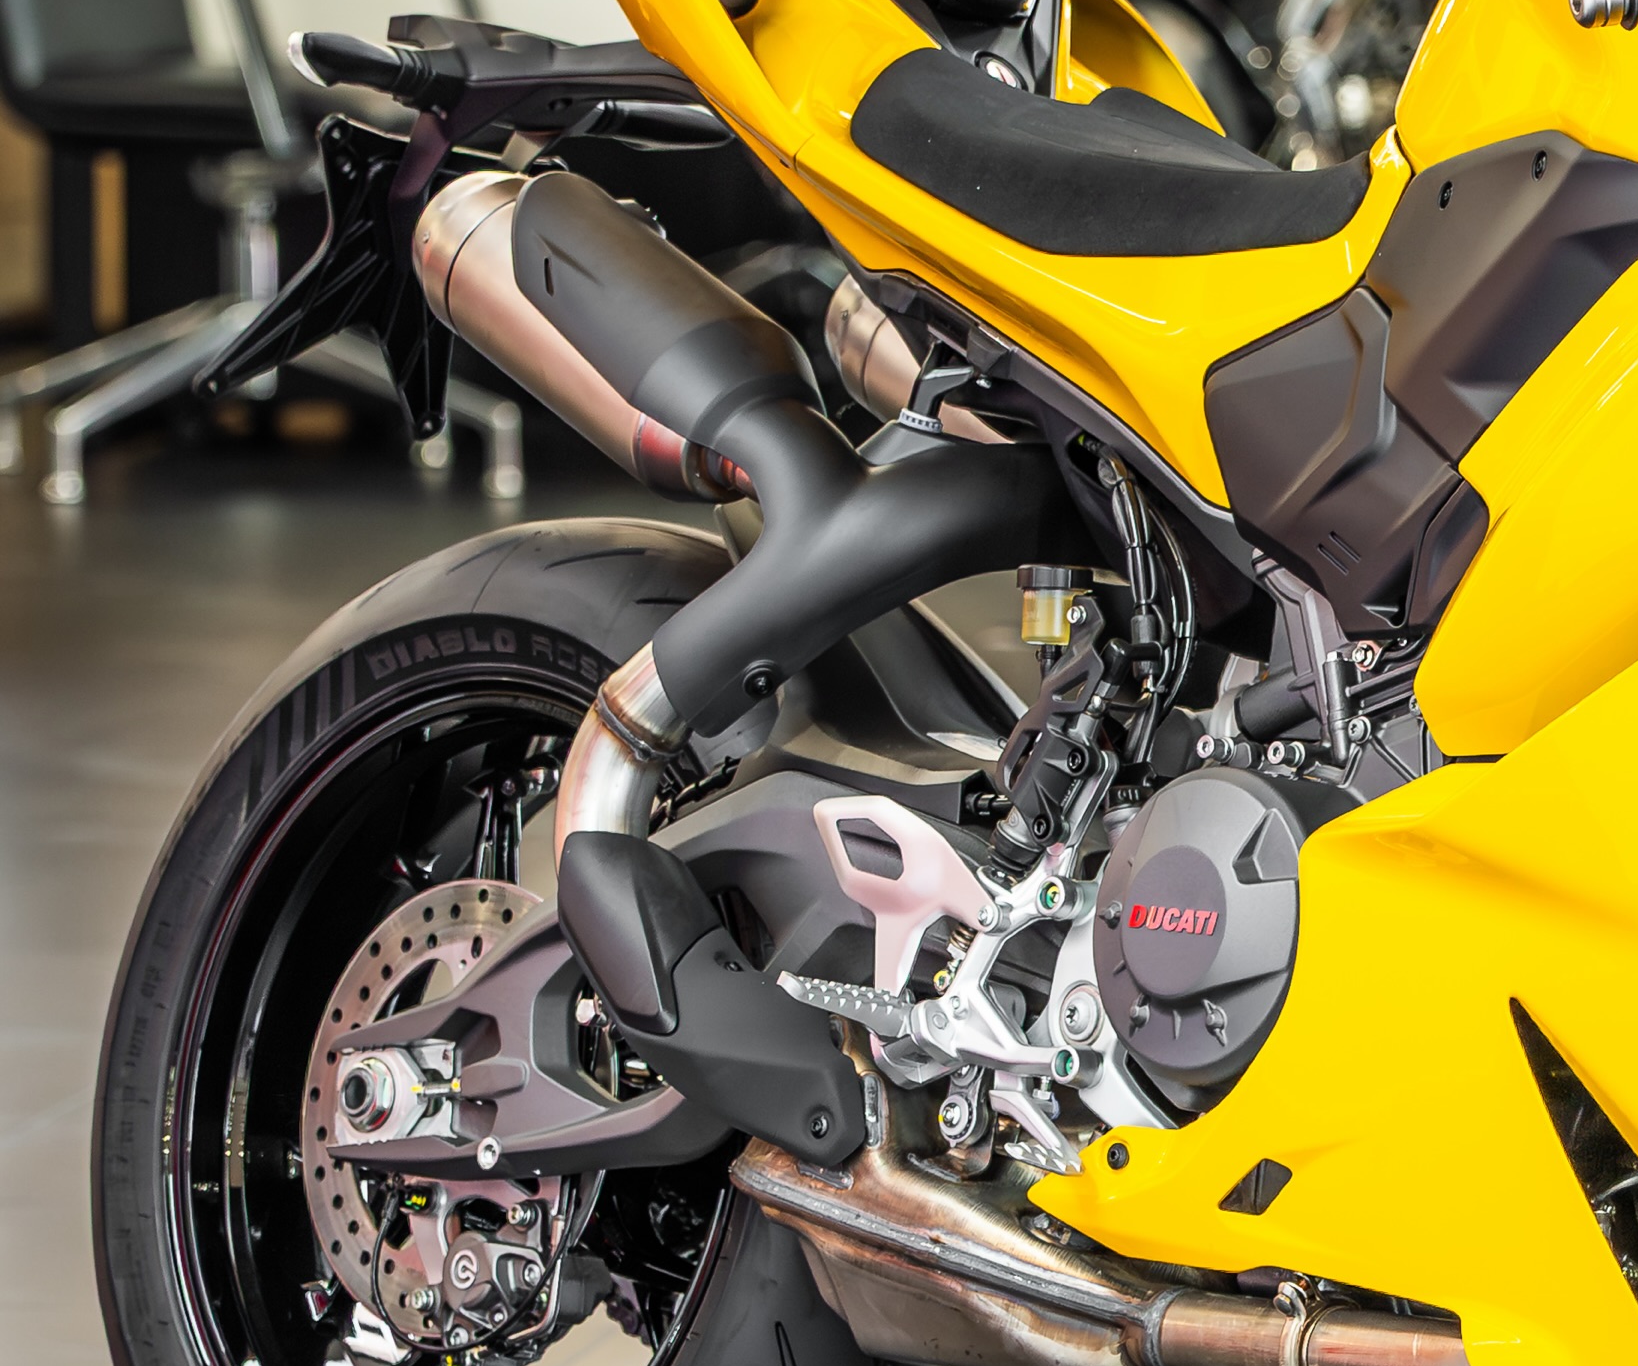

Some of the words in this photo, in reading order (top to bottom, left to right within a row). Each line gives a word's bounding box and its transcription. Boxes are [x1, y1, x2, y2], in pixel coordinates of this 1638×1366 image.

[366, 626, 518, 681] DIABLO
[530, 635, 612, 684] ROS
[1128, 904, 1219, 936] DUCATI
